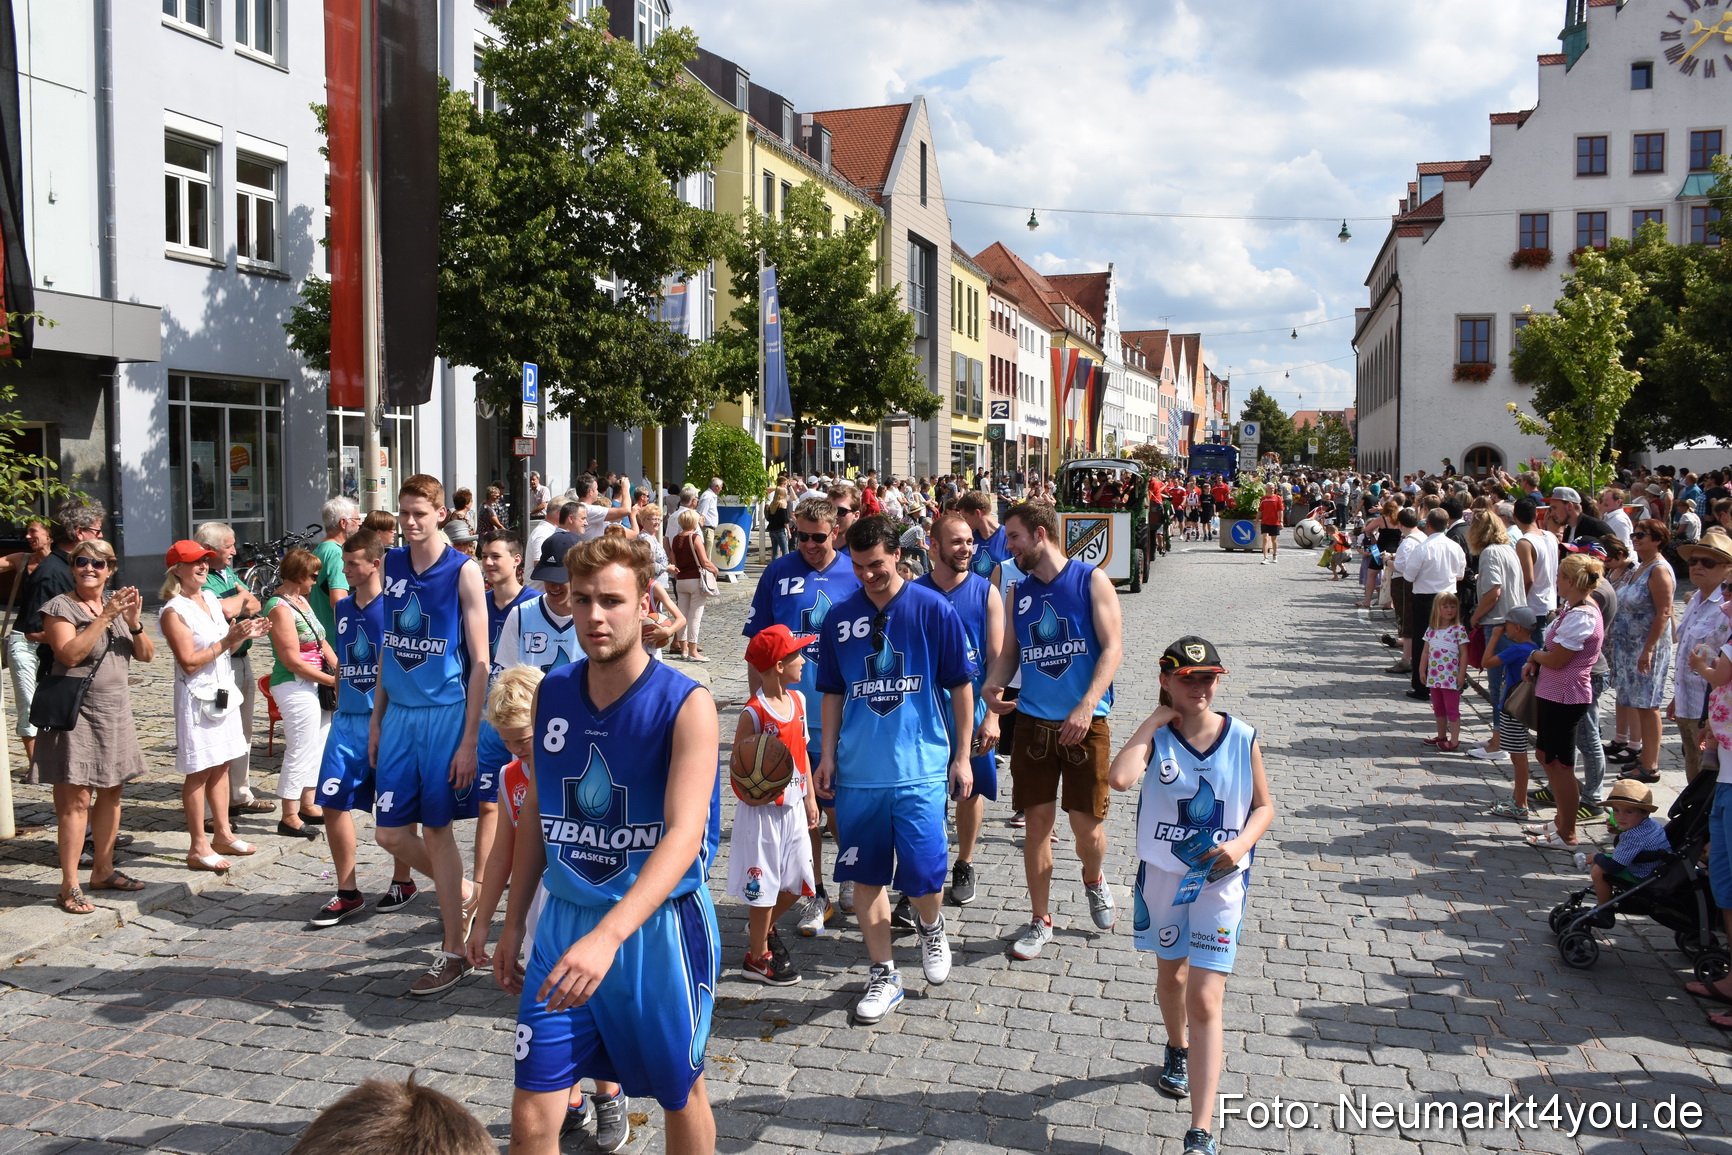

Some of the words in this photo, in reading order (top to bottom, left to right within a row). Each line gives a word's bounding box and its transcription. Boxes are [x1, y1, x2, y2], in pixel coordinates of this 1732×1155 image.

[526, 368, 535, 398] P
[833, 428, 842, 445] P
[1078, 531, 1106, 562] TSV
[778, 577, 805, 596] 12
[1018, 595, 1033, 615] 9
[337, 616, 348, 635] 6
[837, 616, 871, 642] 36
[384, 632, 444, 654] FIBALON
[523, 632, 548, 653] 13
[1022, 640, 1086, 661] FIBALON
[1040, 658, 1067, 667] BASKETS
[853, 677, 920, 698] FIBALON
[543, 717, 569, 752] 8
[479, 773, 493, 790] 5
[1159, 758, 1180, 785] 9
[321, 777, 342, 796] 6
[541, 819, 659, 850] FIBALON
[570, 850, 617, 865] BASKETS
[838, 846, 859, 866] 4
[1159, 925, 1180, 948] 9
[514, 1023, 533, 1060] 8
